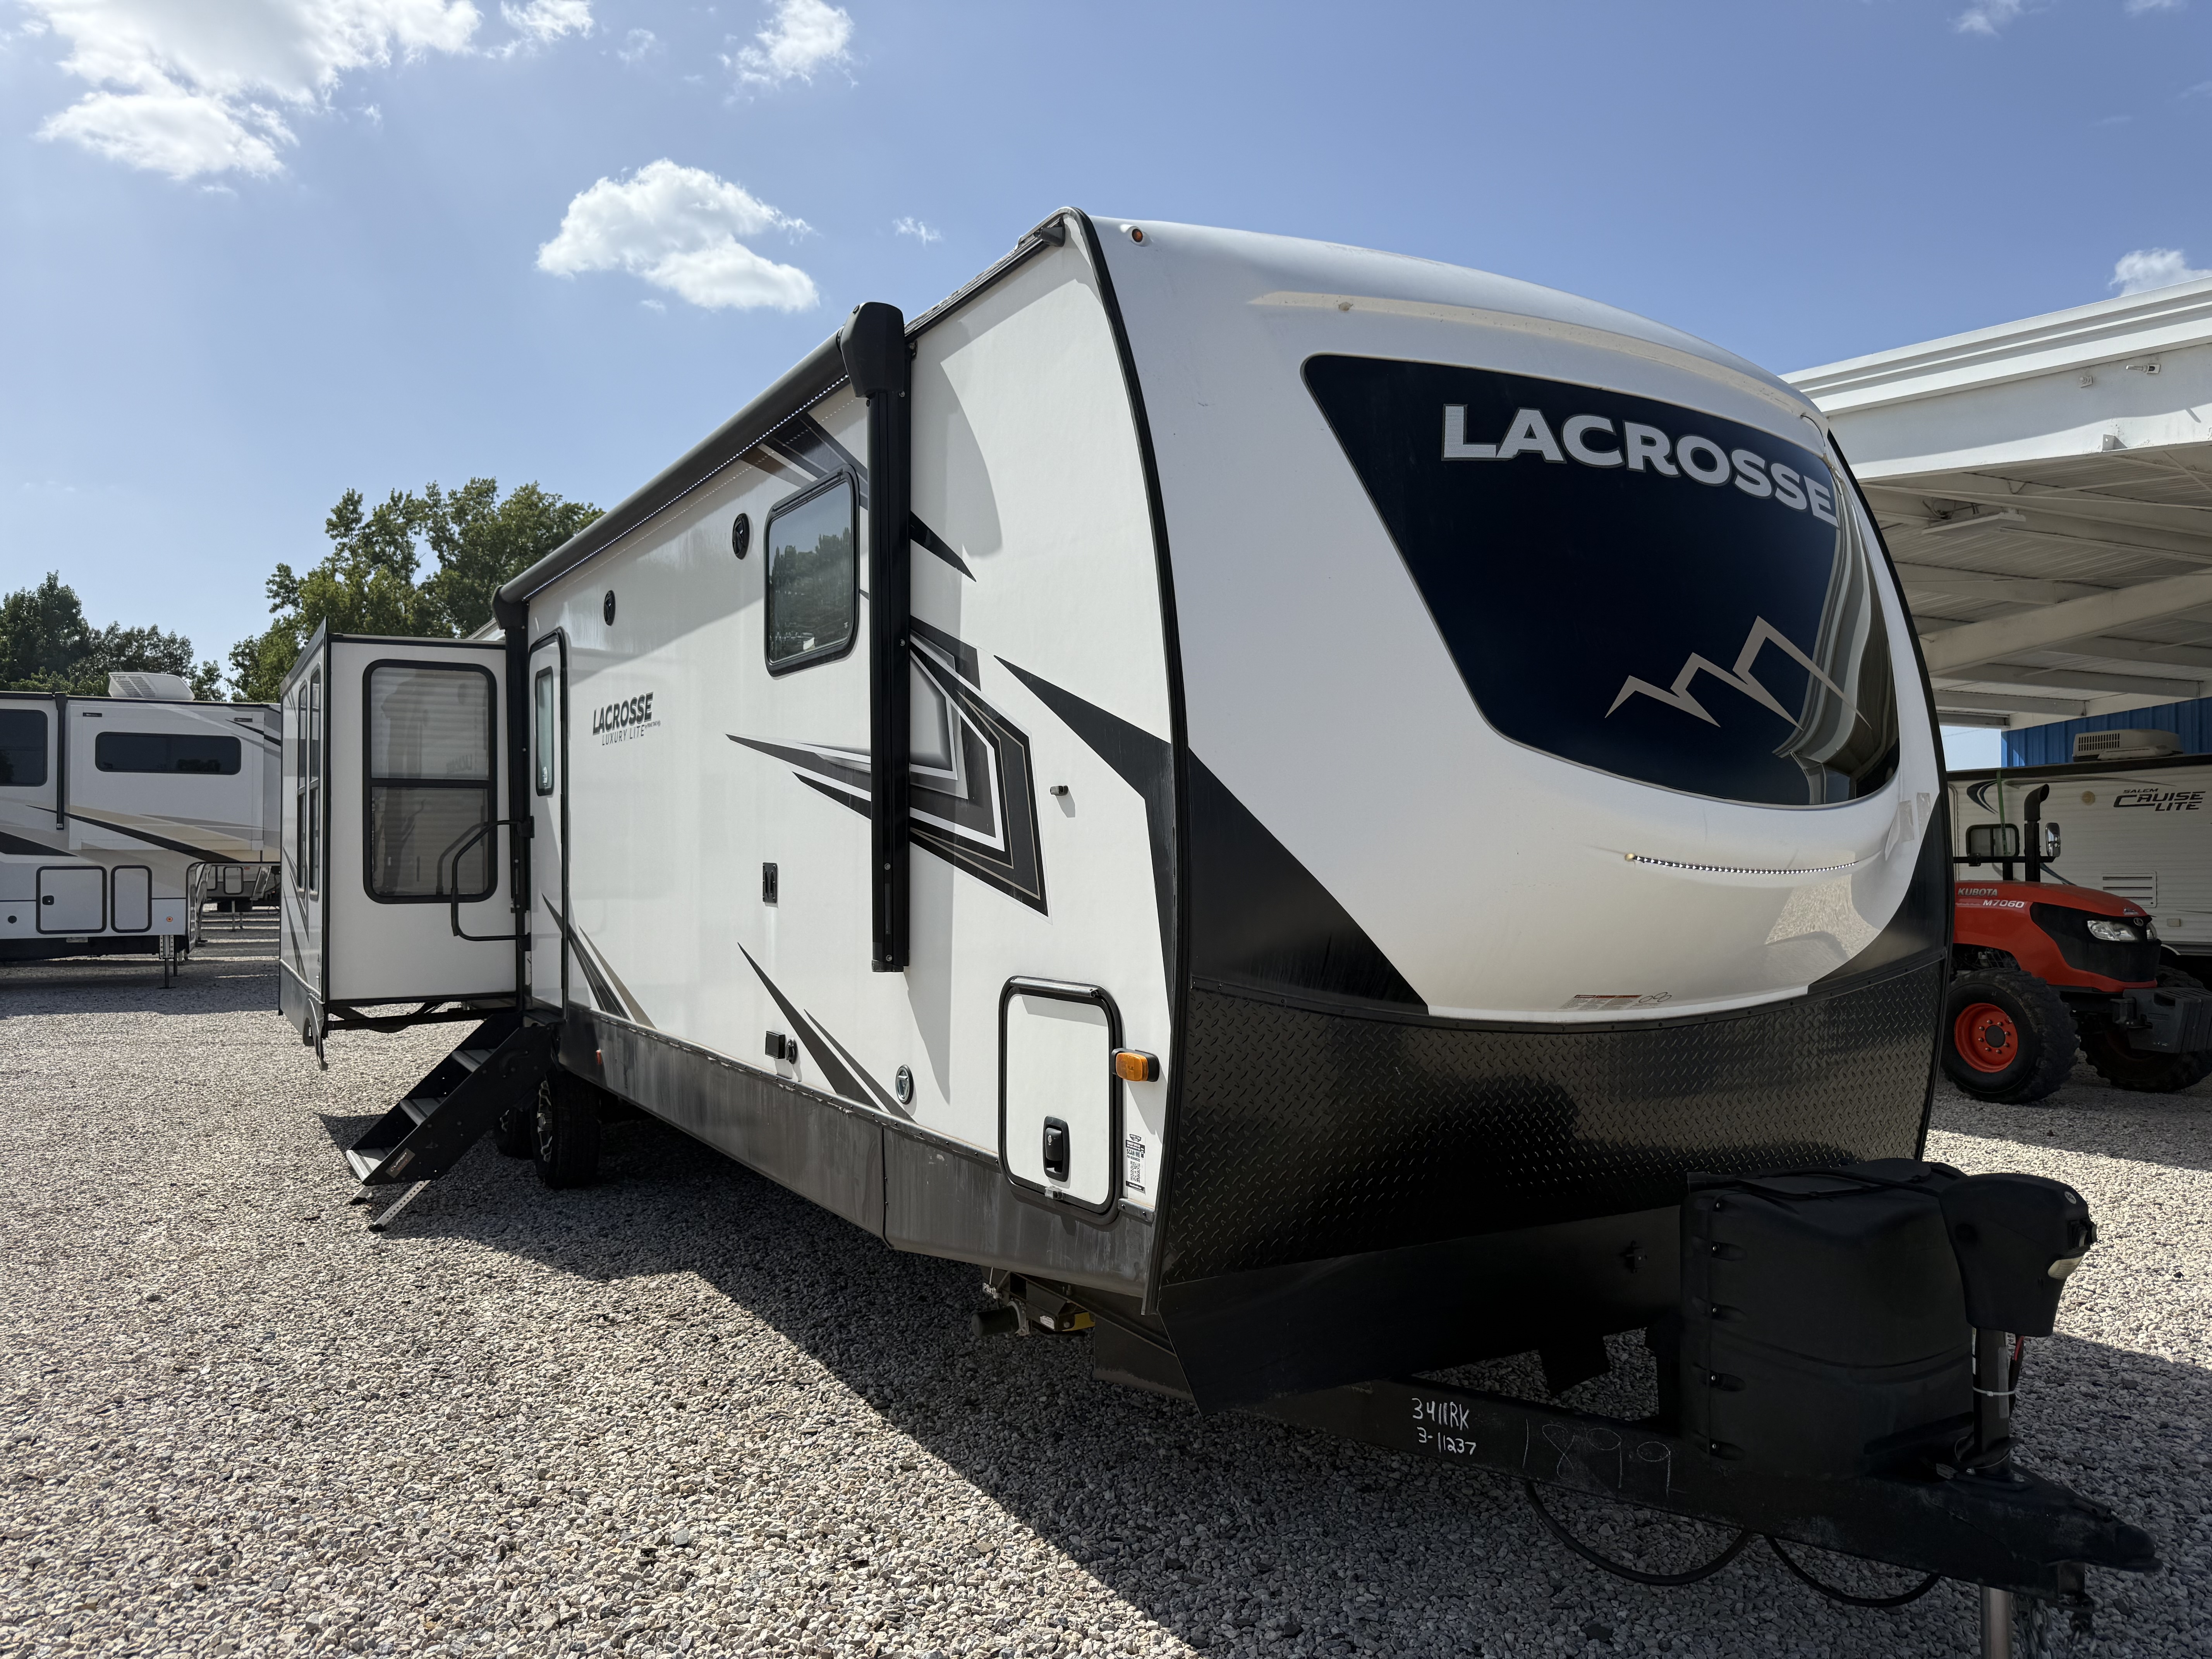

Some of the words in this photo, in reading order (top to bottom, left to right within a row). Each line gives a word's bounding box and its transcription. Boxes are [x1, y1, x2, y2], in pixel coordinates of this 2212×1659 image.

[1441, 404, 1839, 528] LACROSSE
[592, 692, 654, 736] LACROSSE
[602, 729, 627, 745] LUXURY
[630, 725, 645, 739] LITE
[2113, 791, 2206, 807] CRUISE
[2155, 801, 2202, 811] LITE
[1958, 888, 1998, 896] KUBOTA
[1982, 900, 2025, 908] M7060
[1522, 1418, 1671, 1498] 1899
